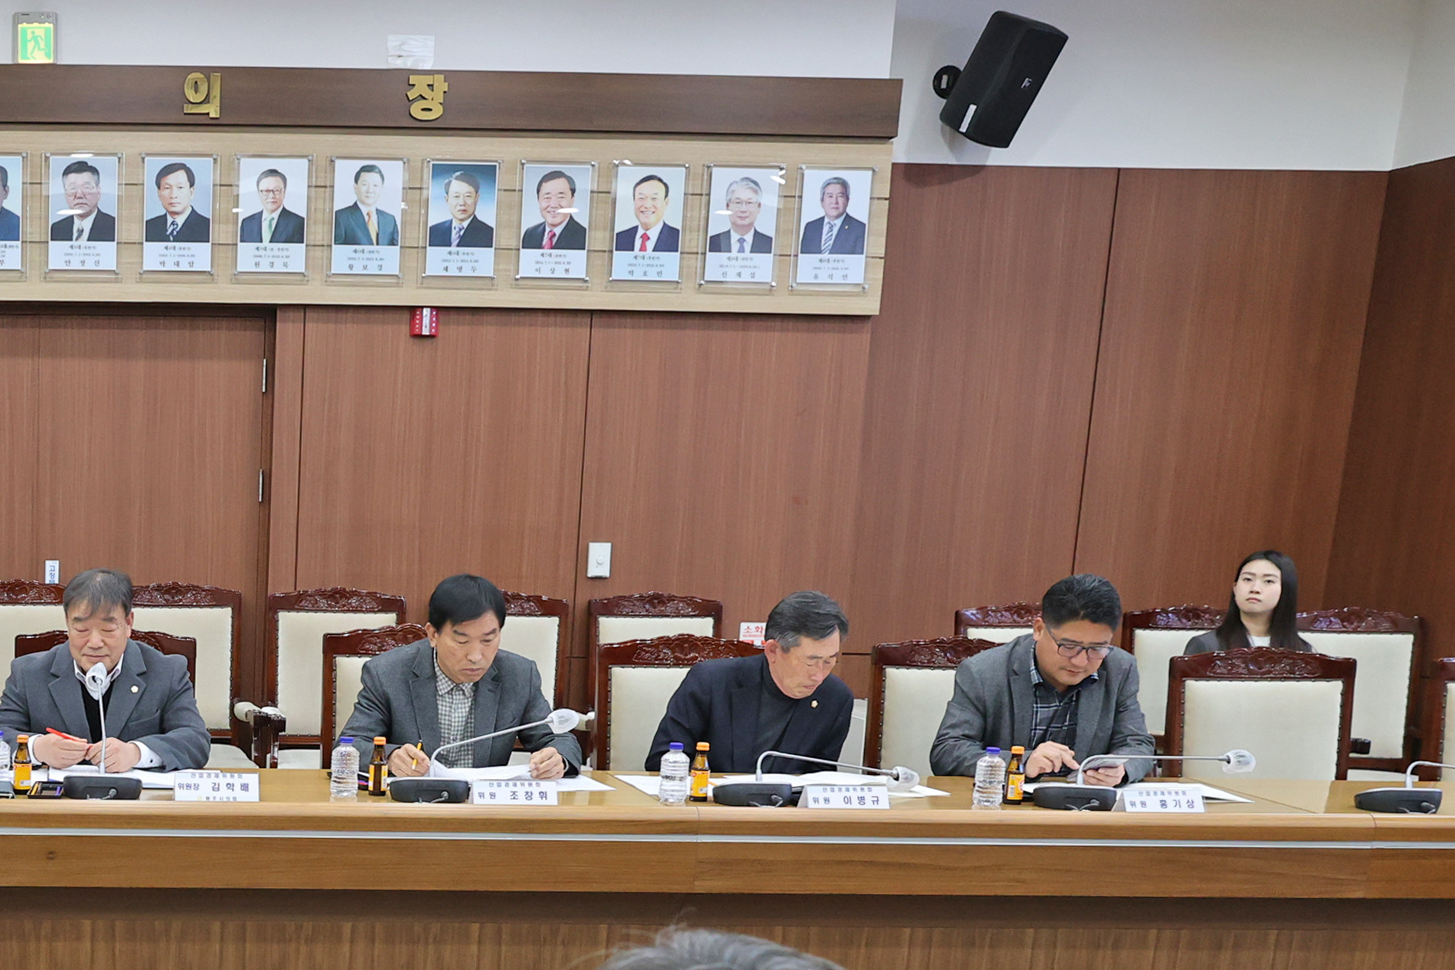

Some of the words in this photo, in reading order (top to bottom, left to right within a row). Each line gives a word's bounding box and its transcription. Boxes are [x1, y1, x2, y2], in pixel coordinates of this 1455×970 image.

[183, 72, 220, 118] 의
[407, 73, 448, 121] 장
[177, 782, 200, 791] 위원장
[211, 782, 249, 792] 김학배
[478, 791, 496, 800] 위원
[812, 796, 831, 804] 위원
[843, 795, 880, 805] 이병규
[1129, 800, 1147, 808] 위원
